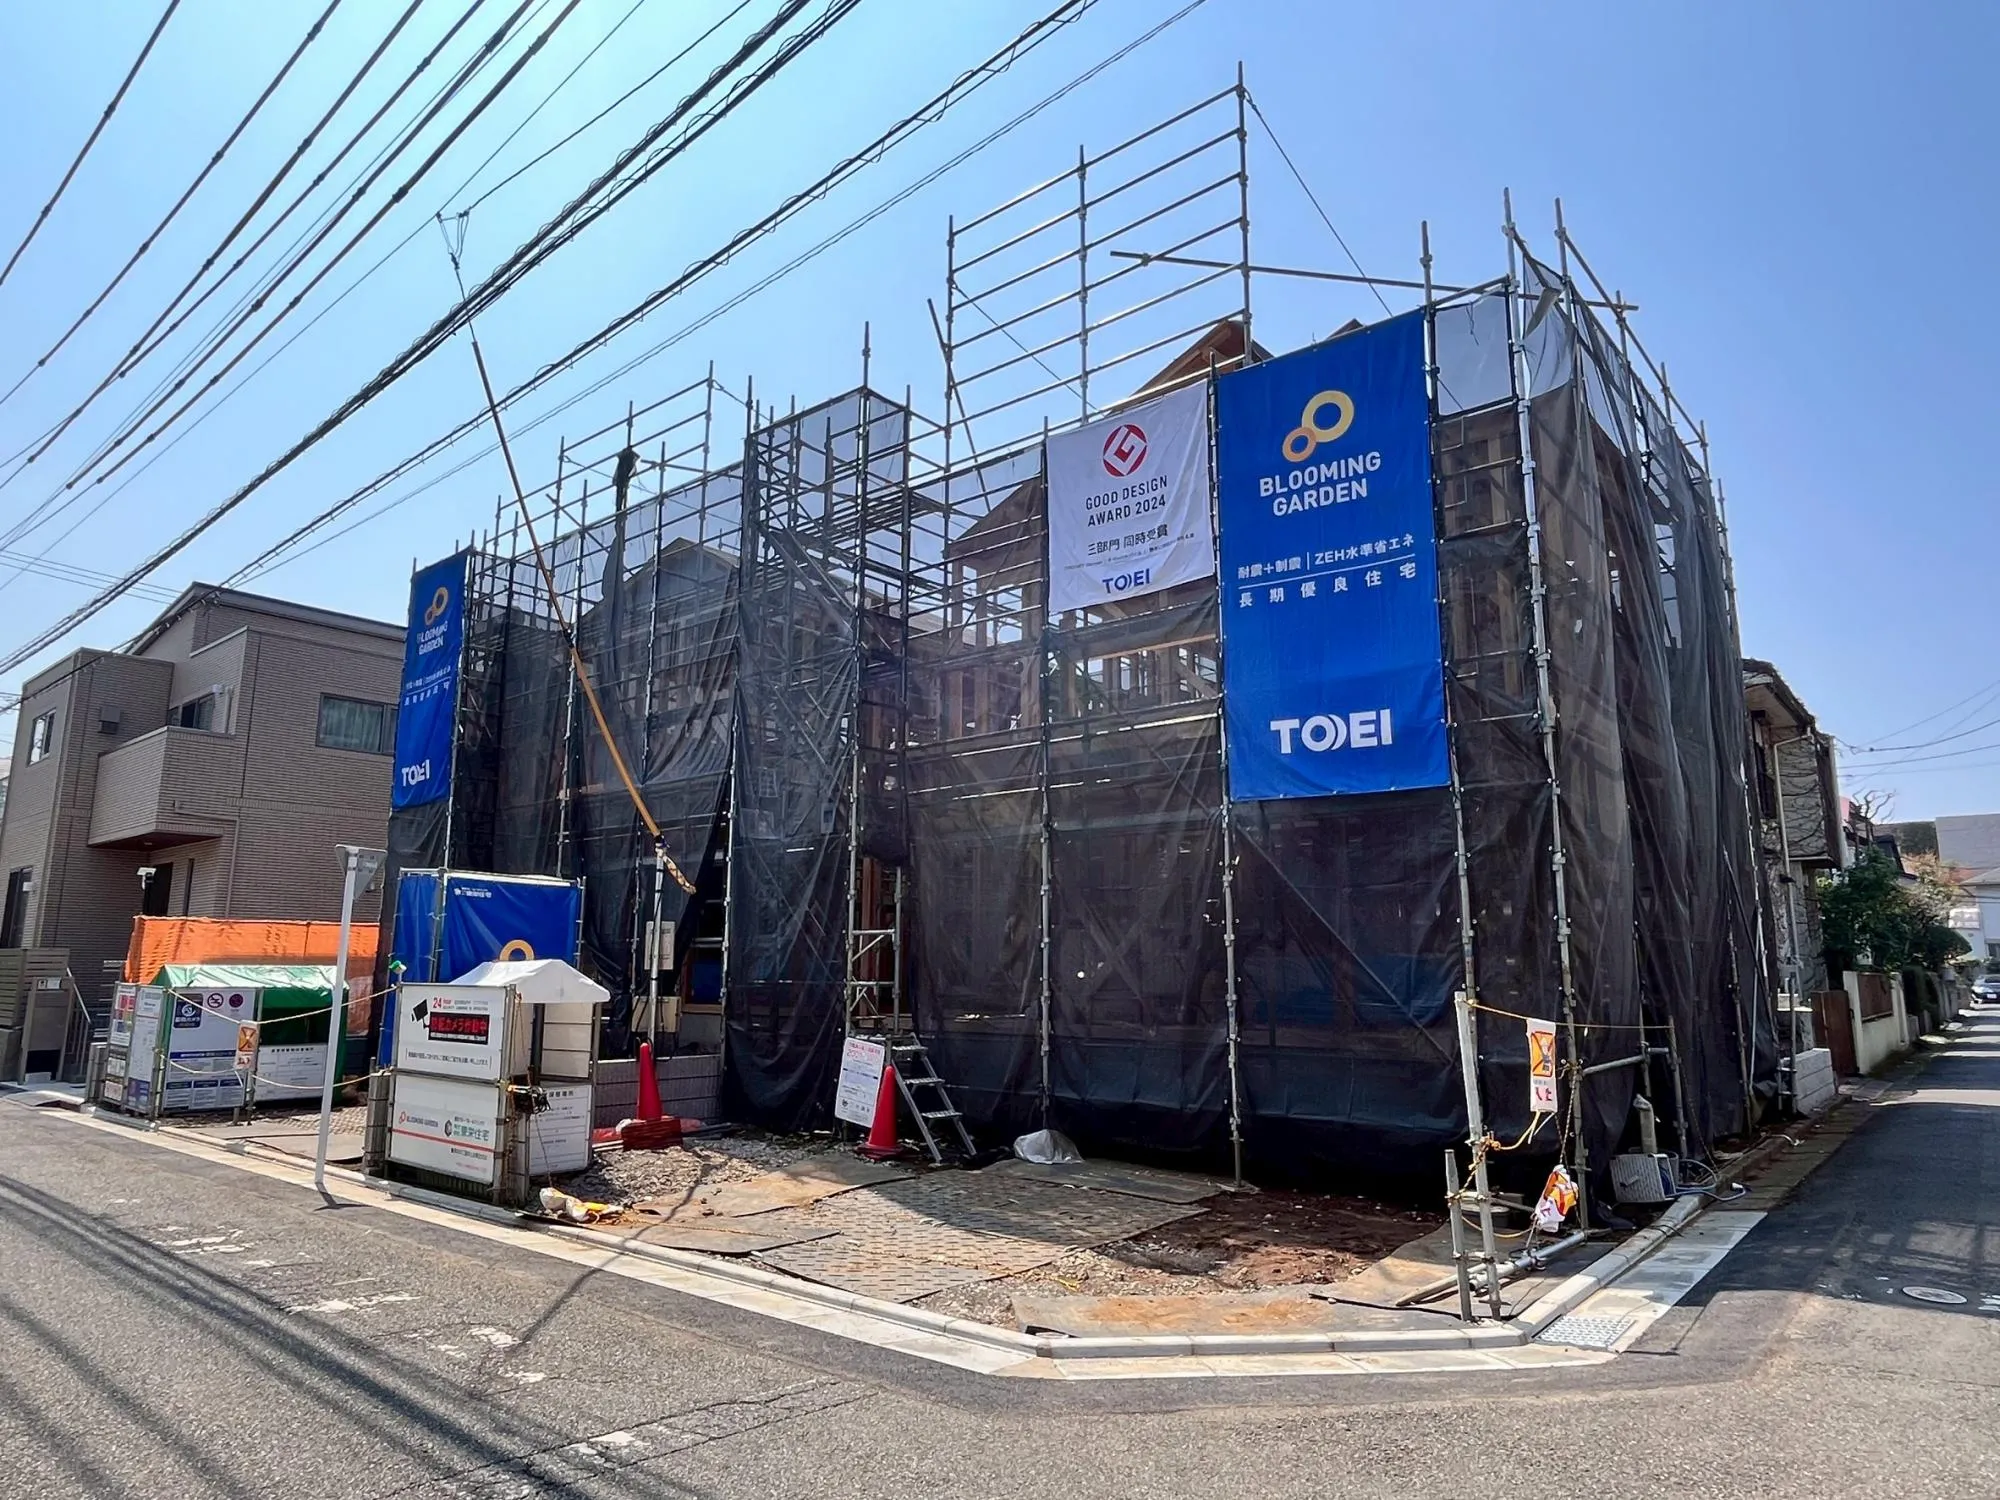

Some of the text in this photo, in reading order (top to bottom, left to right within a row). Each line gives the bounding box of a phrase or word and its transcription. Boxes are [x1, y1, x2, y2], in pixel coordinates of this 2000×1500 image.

[1259, 451, 1382, 497] BLOOMING
[1086, 475, 1168, 511] GOOD DESIGN
[1272, 478, 1368, 516] GARDEN
[1088, 494, 1166, 527] AWARD 2024
[1088, 538, 1120, 556] 三部門
[1123, 524, 1168, 548] 同時受賞
[432, 996, 442, 1009] 24
